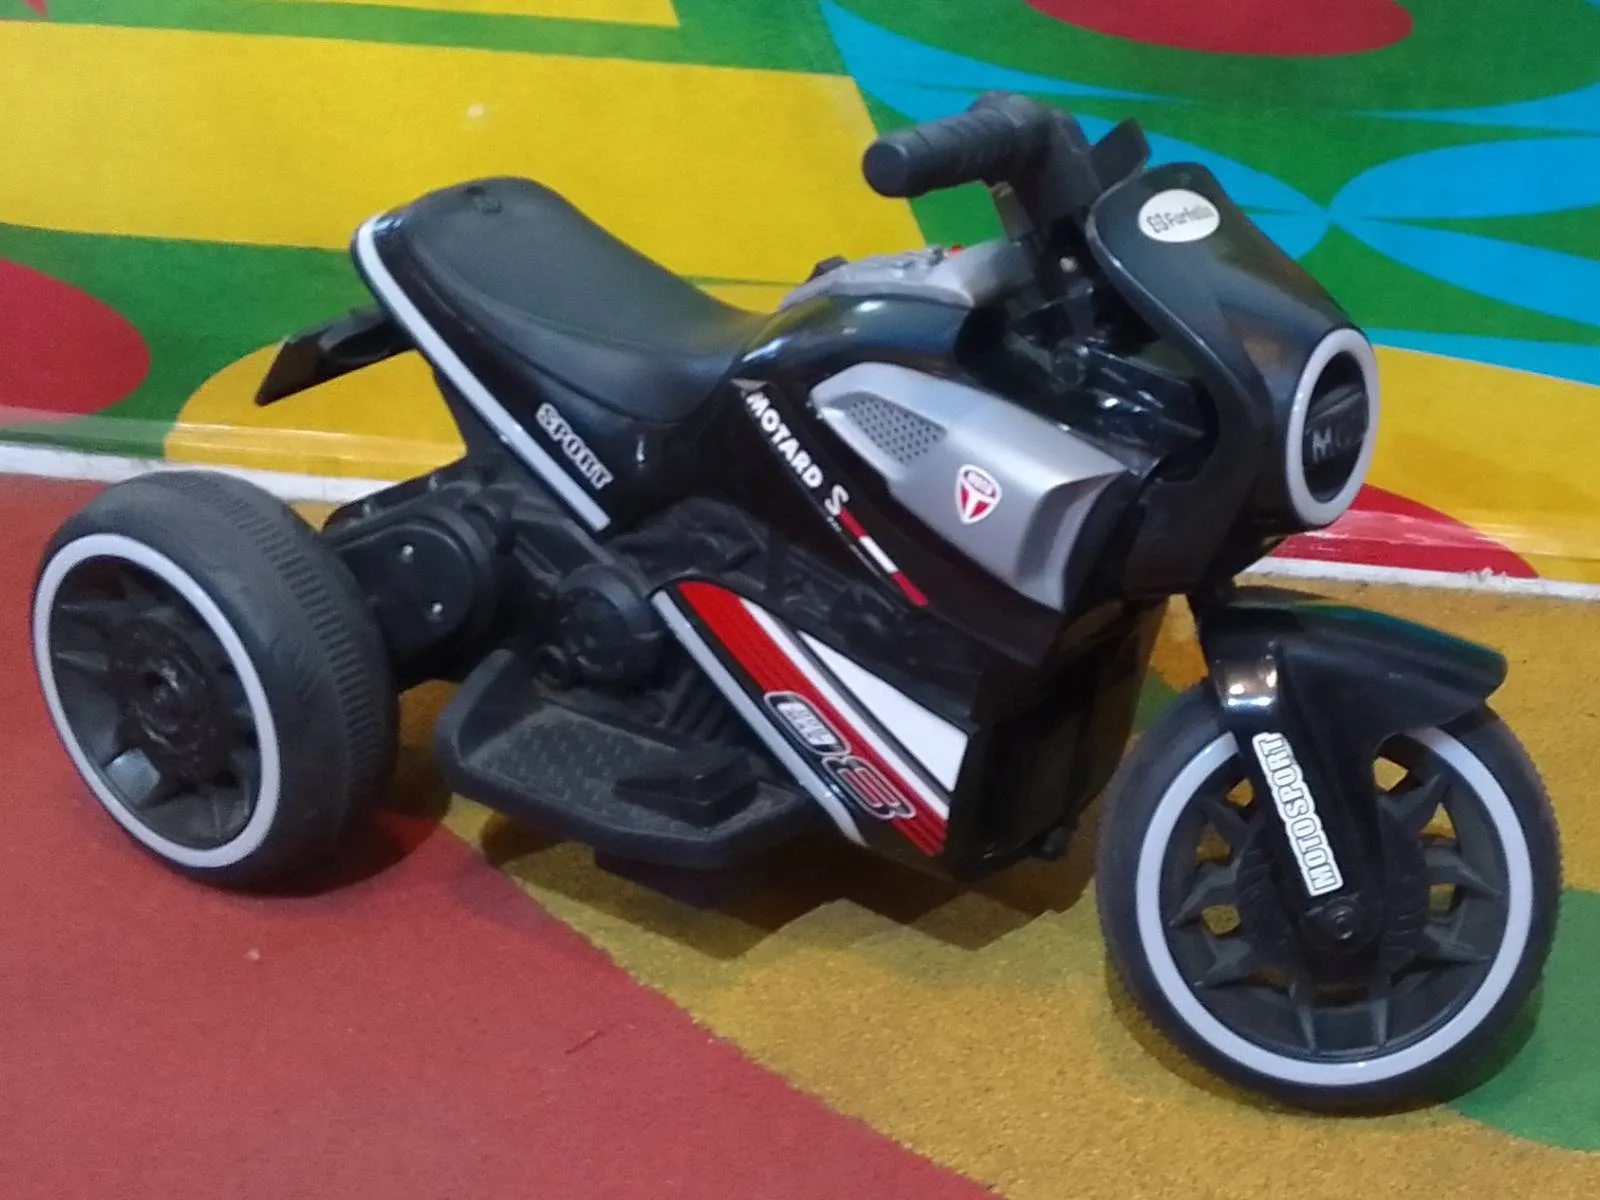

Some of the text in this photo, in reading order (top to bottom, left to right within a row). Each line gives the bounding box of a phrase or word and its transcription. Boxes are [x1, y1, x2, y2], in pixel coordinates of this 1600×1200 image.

[535, 402, 614, 489] SPORT
[745, 391, 850, 517] MOTARD S
[1254, 733, 1342, 895] MOTOSPORT
